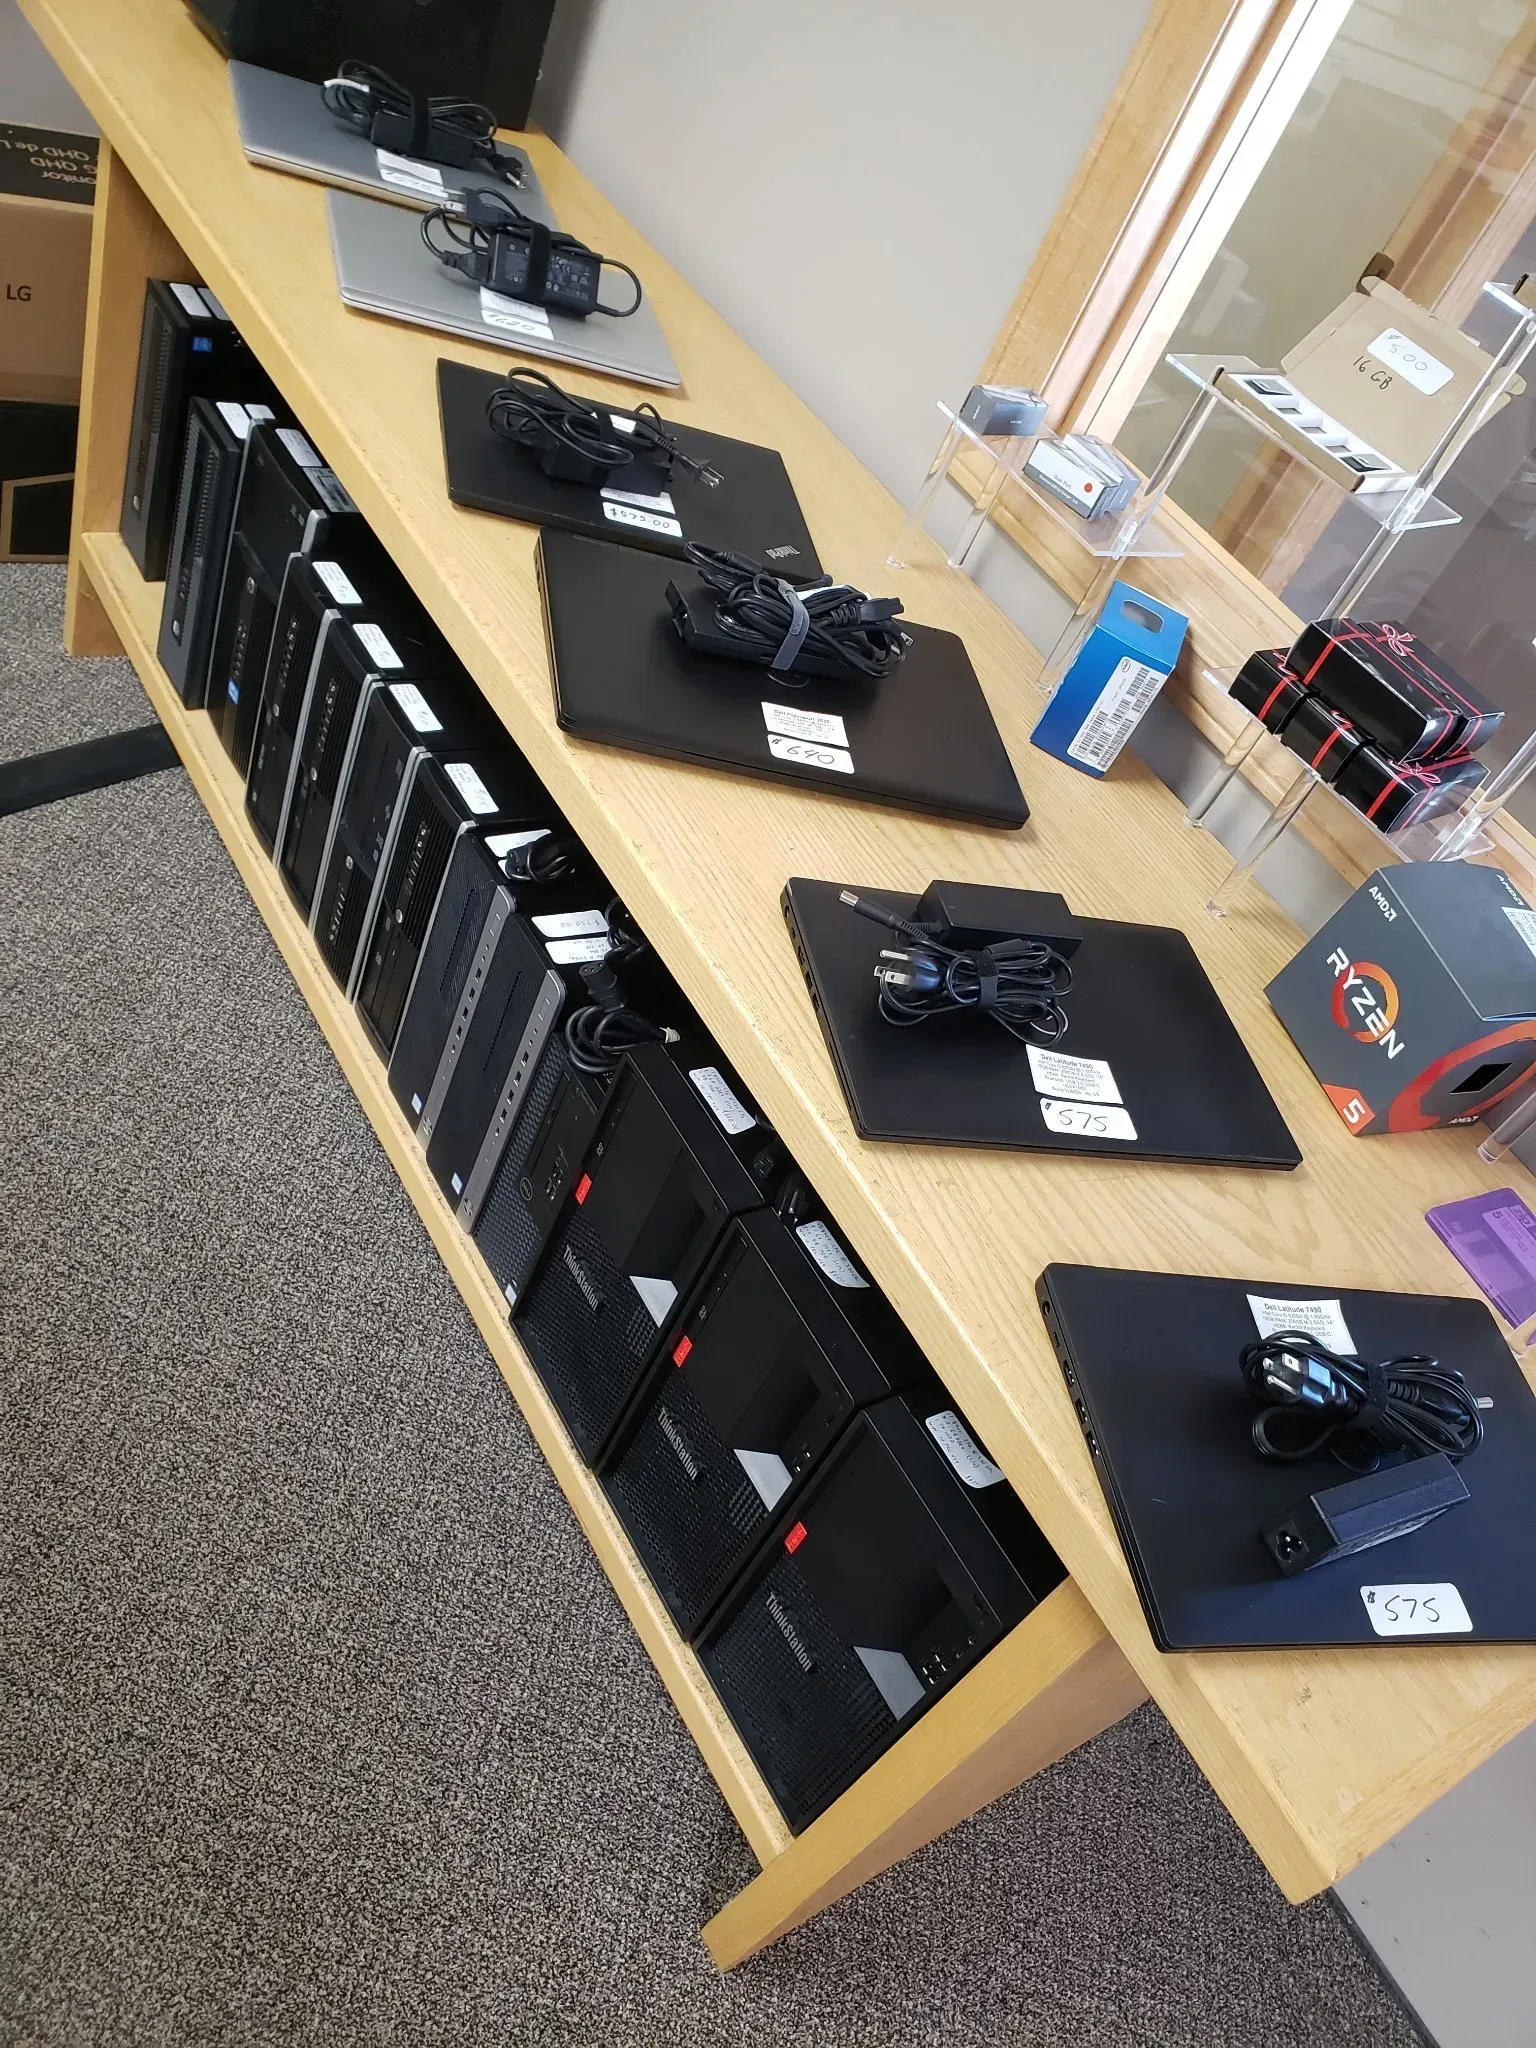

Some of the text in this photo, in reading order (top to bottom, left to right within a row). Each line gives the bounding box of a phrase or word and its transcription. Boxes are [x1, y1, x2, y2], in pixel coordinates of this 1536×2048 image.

[0, 139, 90, 161] QHD de L
[30, 156, 77, 171] QHD
[42, 171, 97, 185] onitor
[6, 284, 32, 302] LG
[1353, 356, 1393, 390] 16 GB
[1368, 886, 1391, 915] AMD
[1496, 874, 1519, 901] AMD
[1326, 947, 1405, 1059] RYZEN
[1041, 1054, 1052, 1062] Dell
[1053, 1056, 1077, 1067] Latitude
[1343, 1098, 1366, 1124] 5
[563, 1245, 599, 1311] ThinkStation
[1264, 1303, 1276, 1311] Dell
[1277, 1304, 1304, 1313] Latitude
[657, 1407, 698, 1481] ThinkStation
[765, 1592, 813, 1672] ThinkStation
